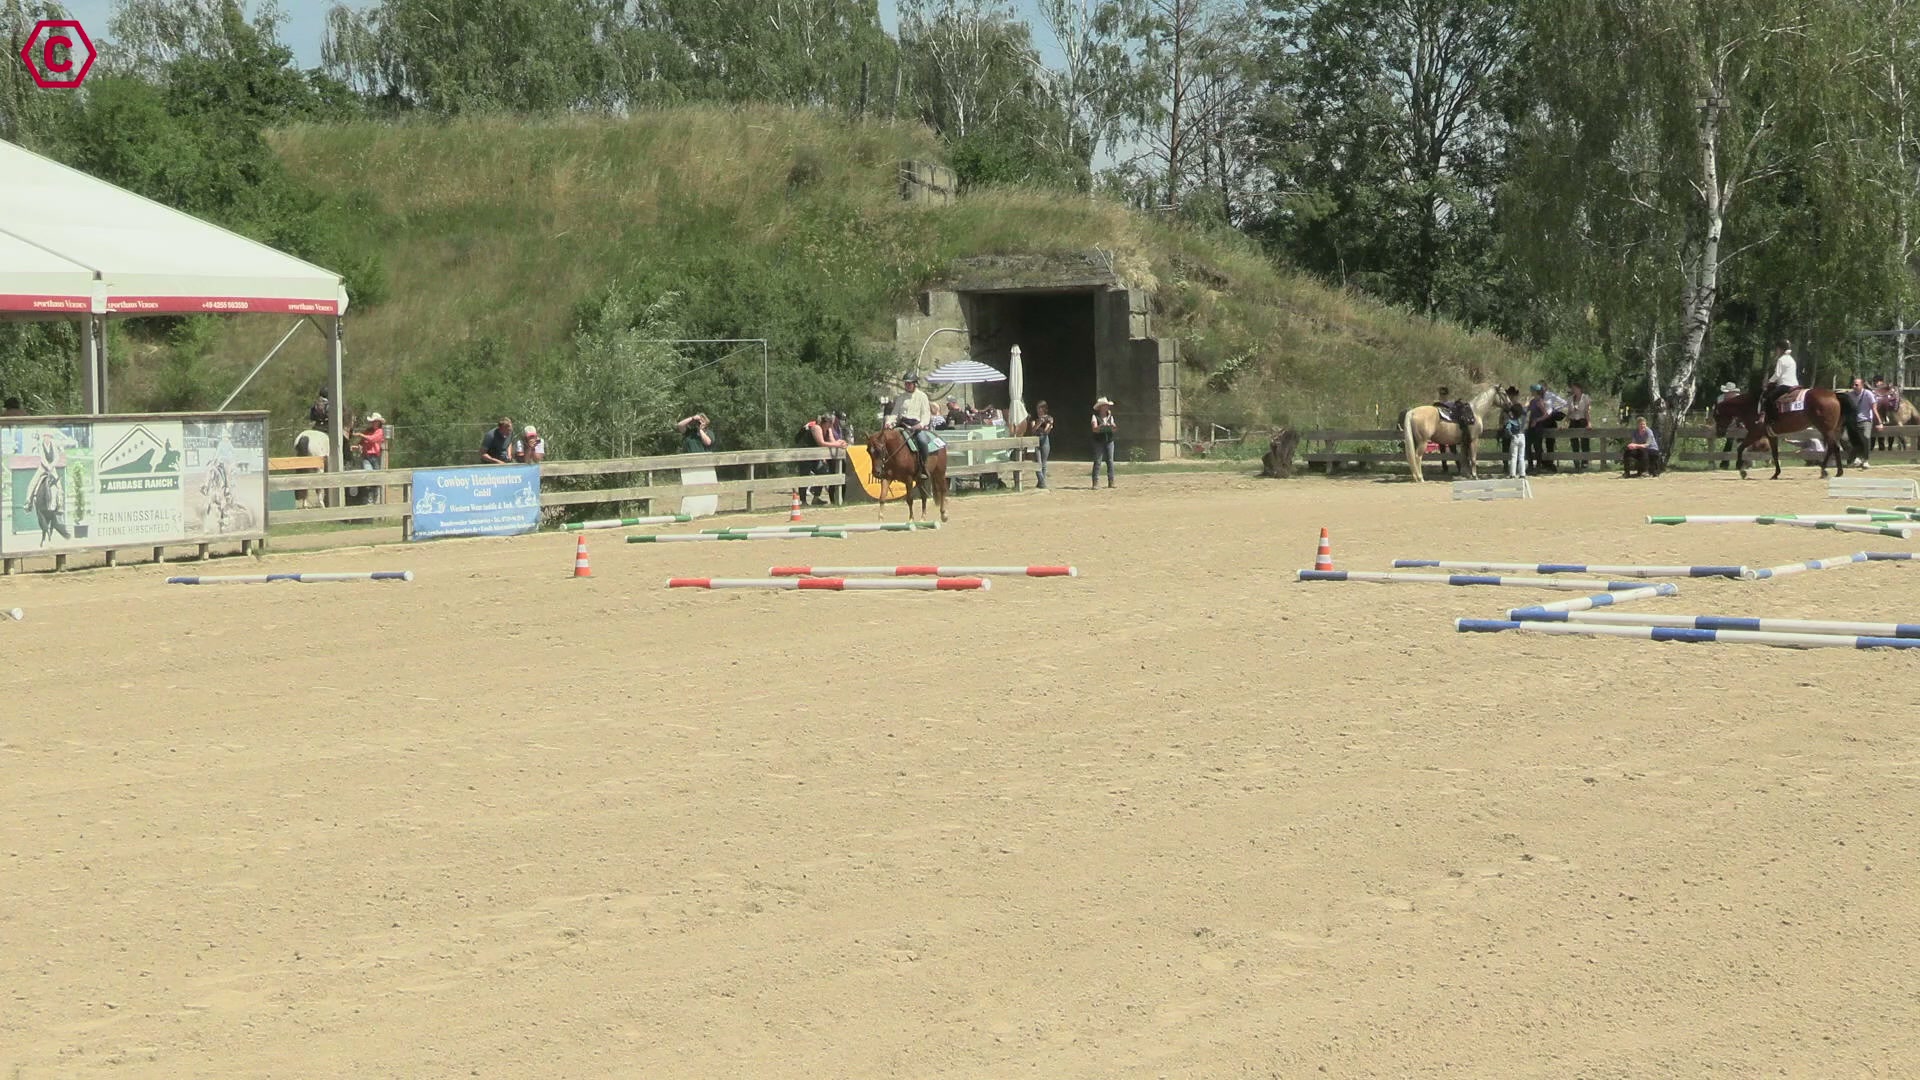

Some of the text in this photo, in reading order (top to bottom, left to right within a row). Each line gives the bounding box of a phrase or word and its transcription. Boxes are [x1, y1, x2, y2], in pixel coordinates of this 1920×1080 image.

[107, 478, 173, 490] AIRBASE RANCH
[437, 474, 522, 488] Cowboy Headquarters
[98, 510, 169, 523] TRAININGSSTALL
[97, 523, 170, 537] ETIENNE HIRSCHFELD
